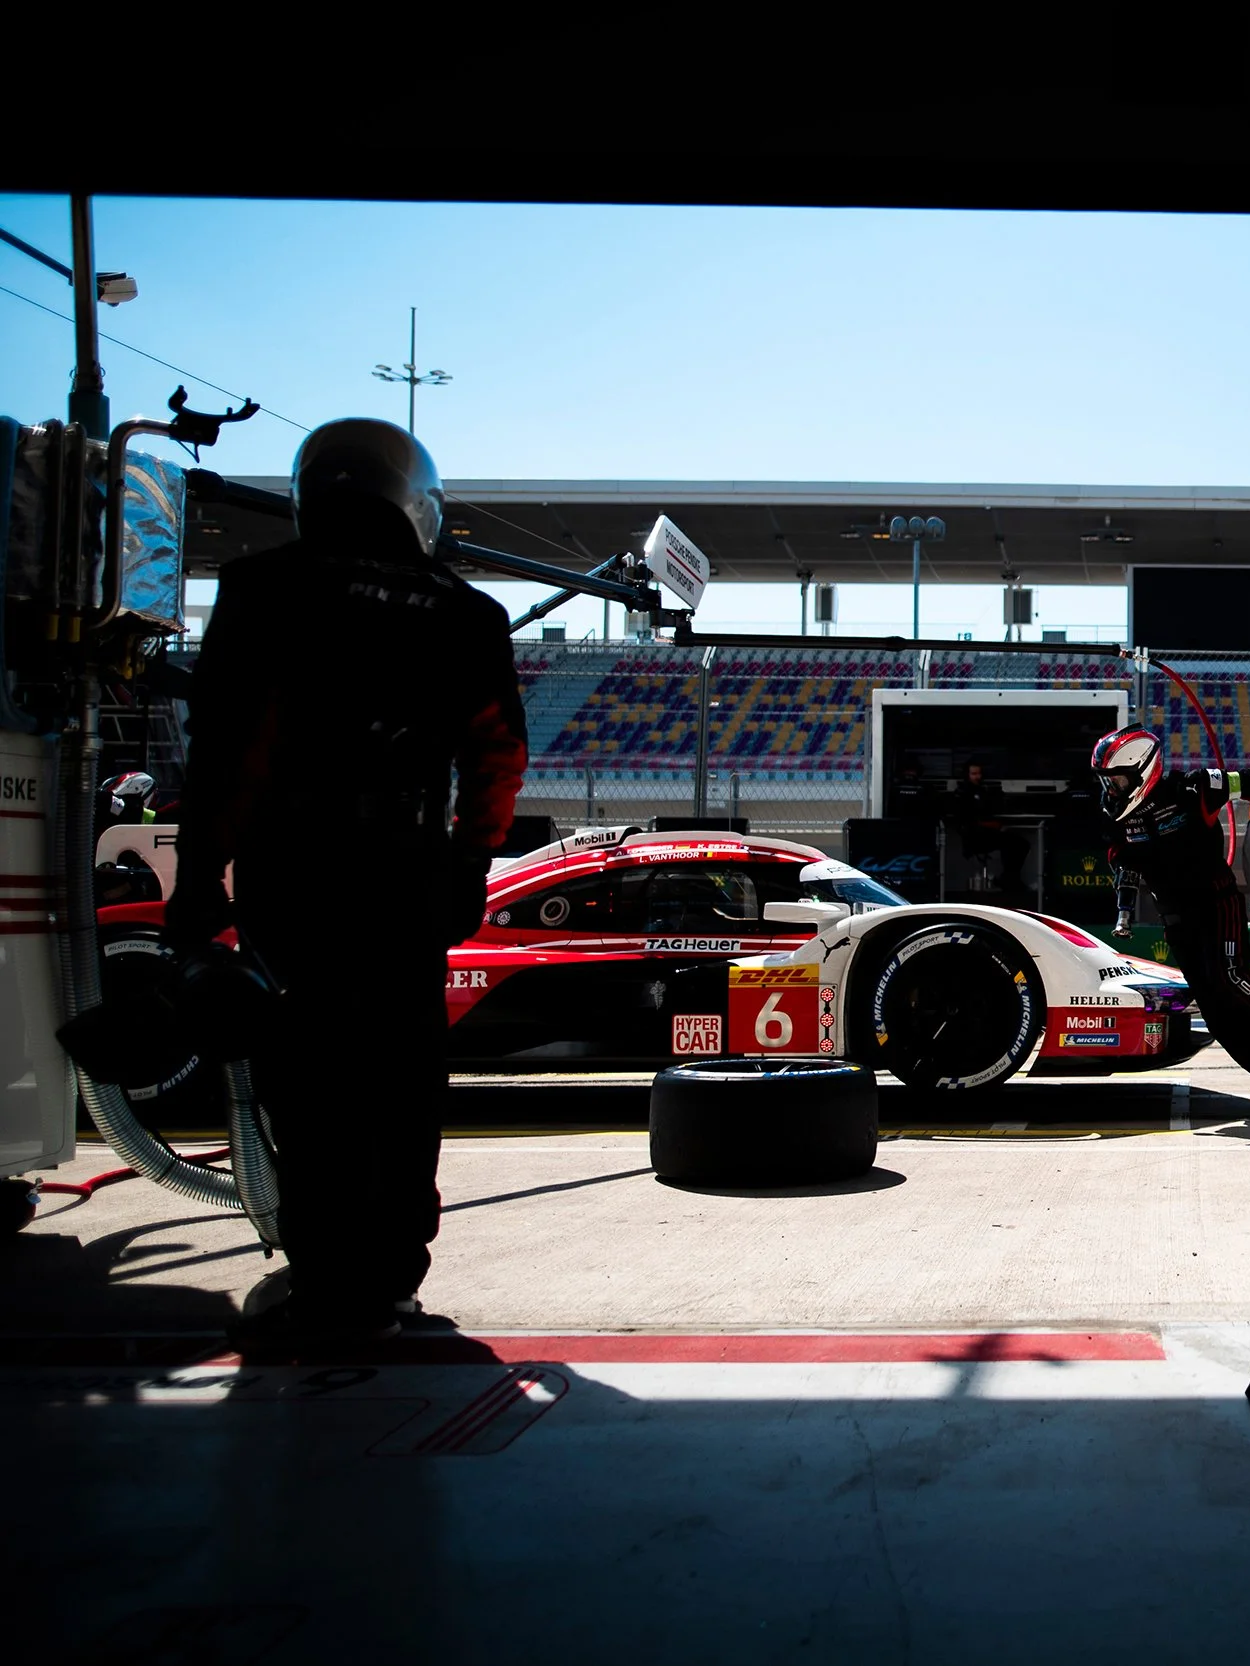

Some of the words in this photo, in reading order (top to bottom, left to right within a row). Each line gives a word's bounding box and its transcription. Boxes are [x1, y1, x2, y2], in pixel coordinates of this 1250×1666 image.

[348, 581, 438, 609] PENKE
[574, 833, 604, 847] Mobil
[639, 855, 647, 863] L.
[649, 852, 700, 862] VANTHOOR
[1061, 874, 1115, 887] ROLEX
[902, 943, 919, 957] PILOT
[917, 935, 940, 950] SPORT
[737, 968, 812, 983] DHL
[874, 960, 898, 1021] MICHELIN
[1069, 996, 1120, 1006] HELLER
[675, 1017, 719, 1031] HYPER
[754, 991, 794, 1048] 6
[1010, 995, 1031, 1056] MICHELIN
[1066, 1016, 1102, 1029] Mobil
[1146, 1024, 1162, 1033] TAG
[675, 1031, 719, 1051] CAR
[161, 1054, 200, 1092] CHELIN
